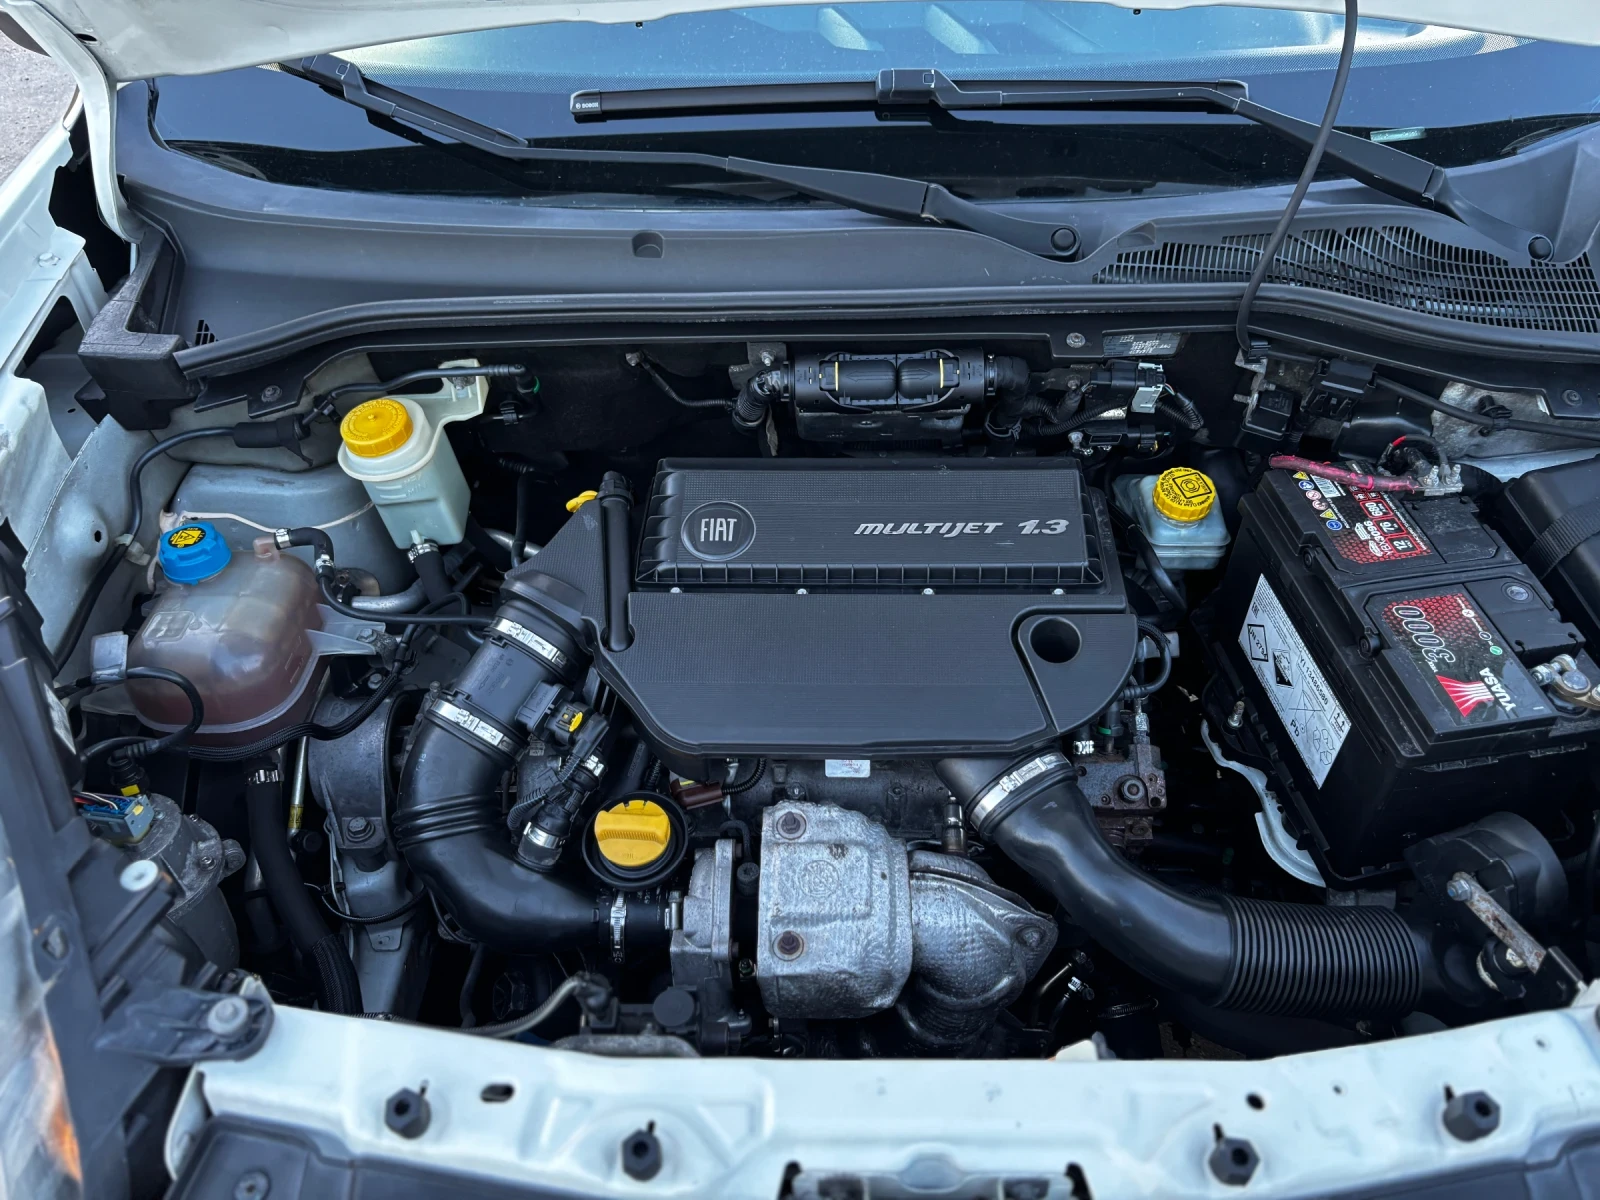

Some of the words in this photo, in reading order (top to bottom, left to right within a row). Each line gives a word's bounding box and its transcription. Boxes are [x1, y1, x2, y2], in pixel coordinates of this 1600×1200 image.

[1365, 502, 1383, 516] 680
[700, 518, 738, 542] FIAT
[854, 522, 1004, 538] MULTIJET
[1018, 518, 1070, 536] 1.3
[1380, 522, 1394, 532] 76
[1364, 520, 1394, 555] YBX3096
[1393, 540, 1408, 550] 12
[1393, 606, 1456, 662] 3000
[1480, 667, 1516, 712] YUASA
[1290, 719, 1300, 736] Pb
